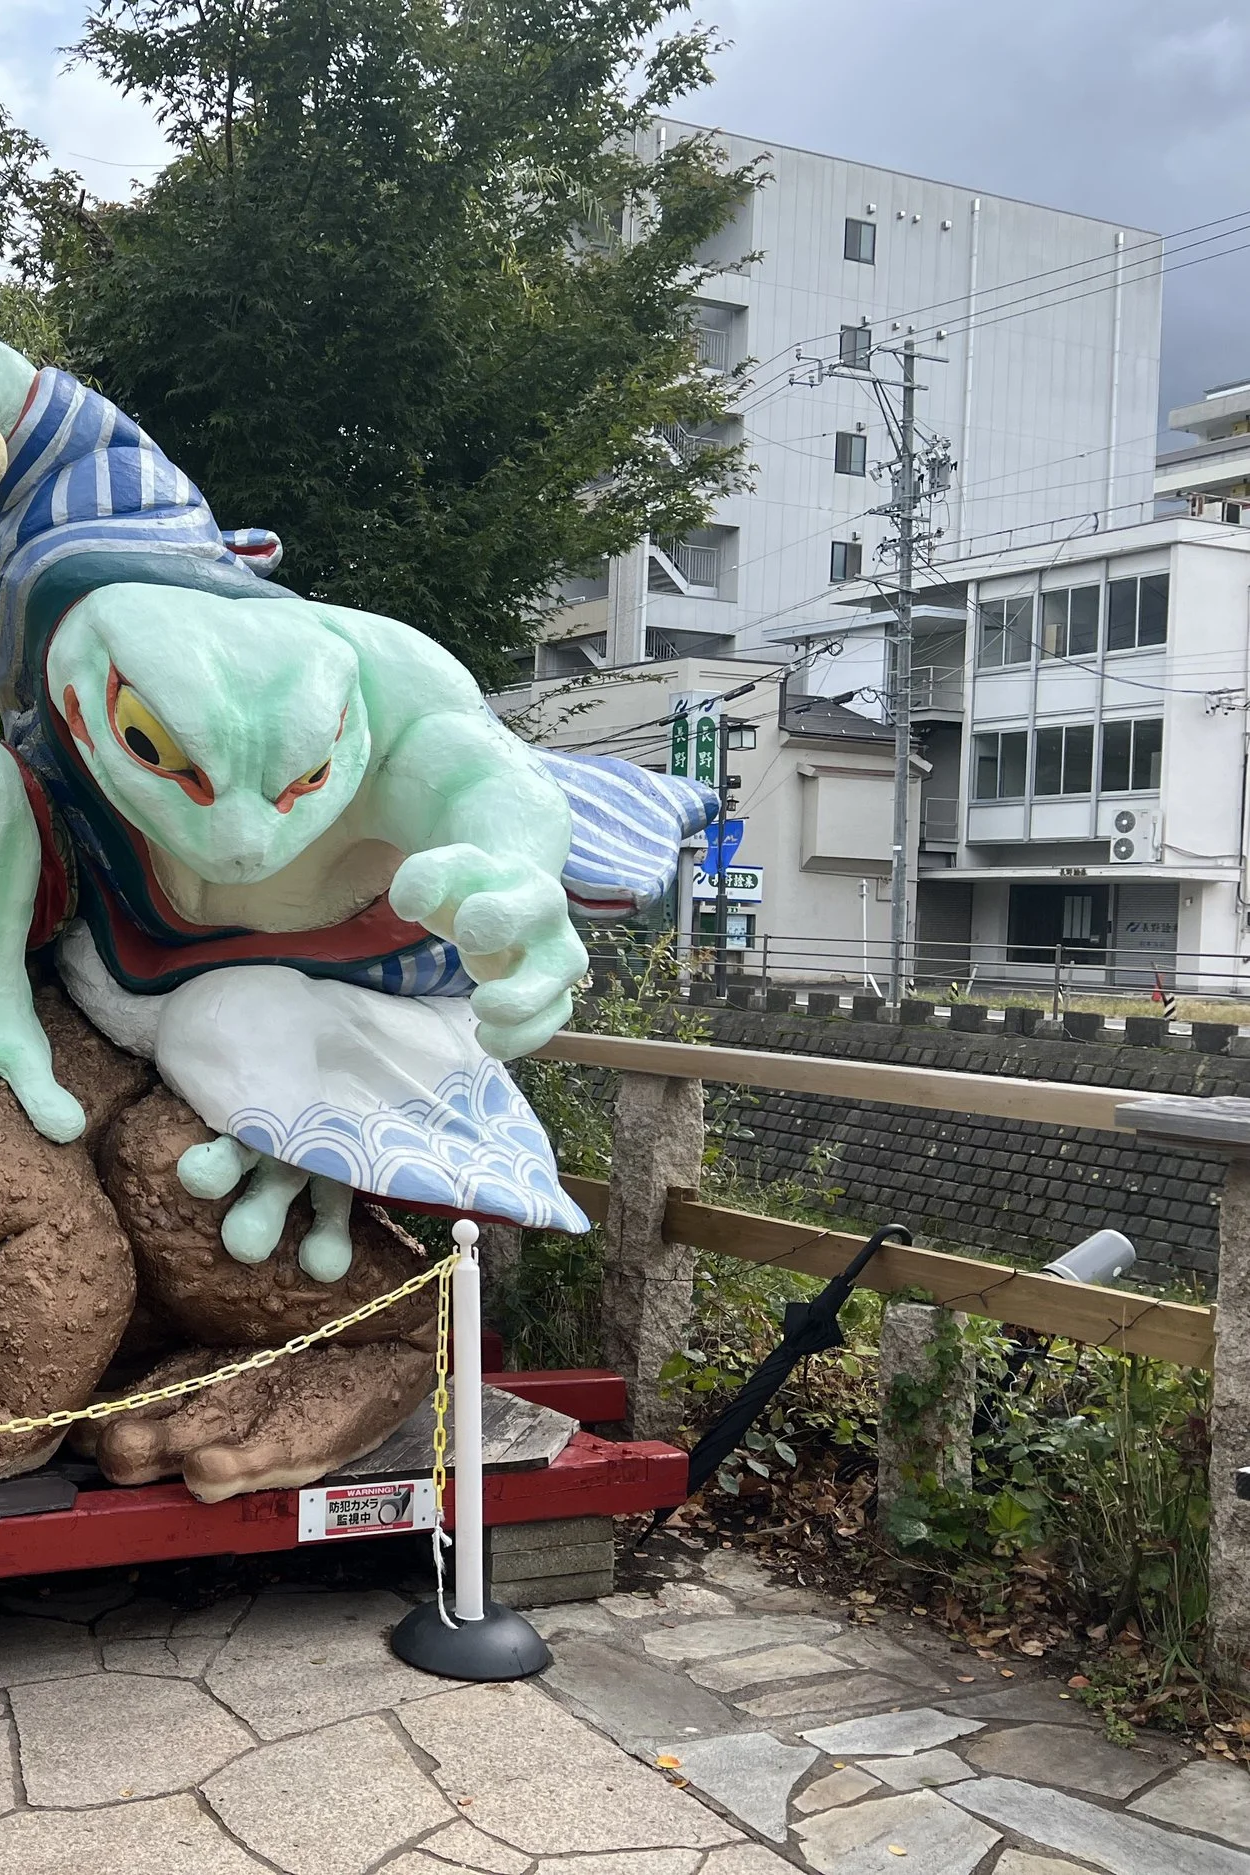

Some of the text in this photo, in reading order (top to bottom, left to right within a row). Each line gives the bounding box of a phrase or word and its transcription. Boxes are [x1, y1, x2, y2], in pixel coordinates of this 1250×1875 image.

[347, 1486, 394, 1497] WARNING!
[329, 1498, 378, 1513] 防犯カメラ
[337, 1512, 371, 1525] 監視中
